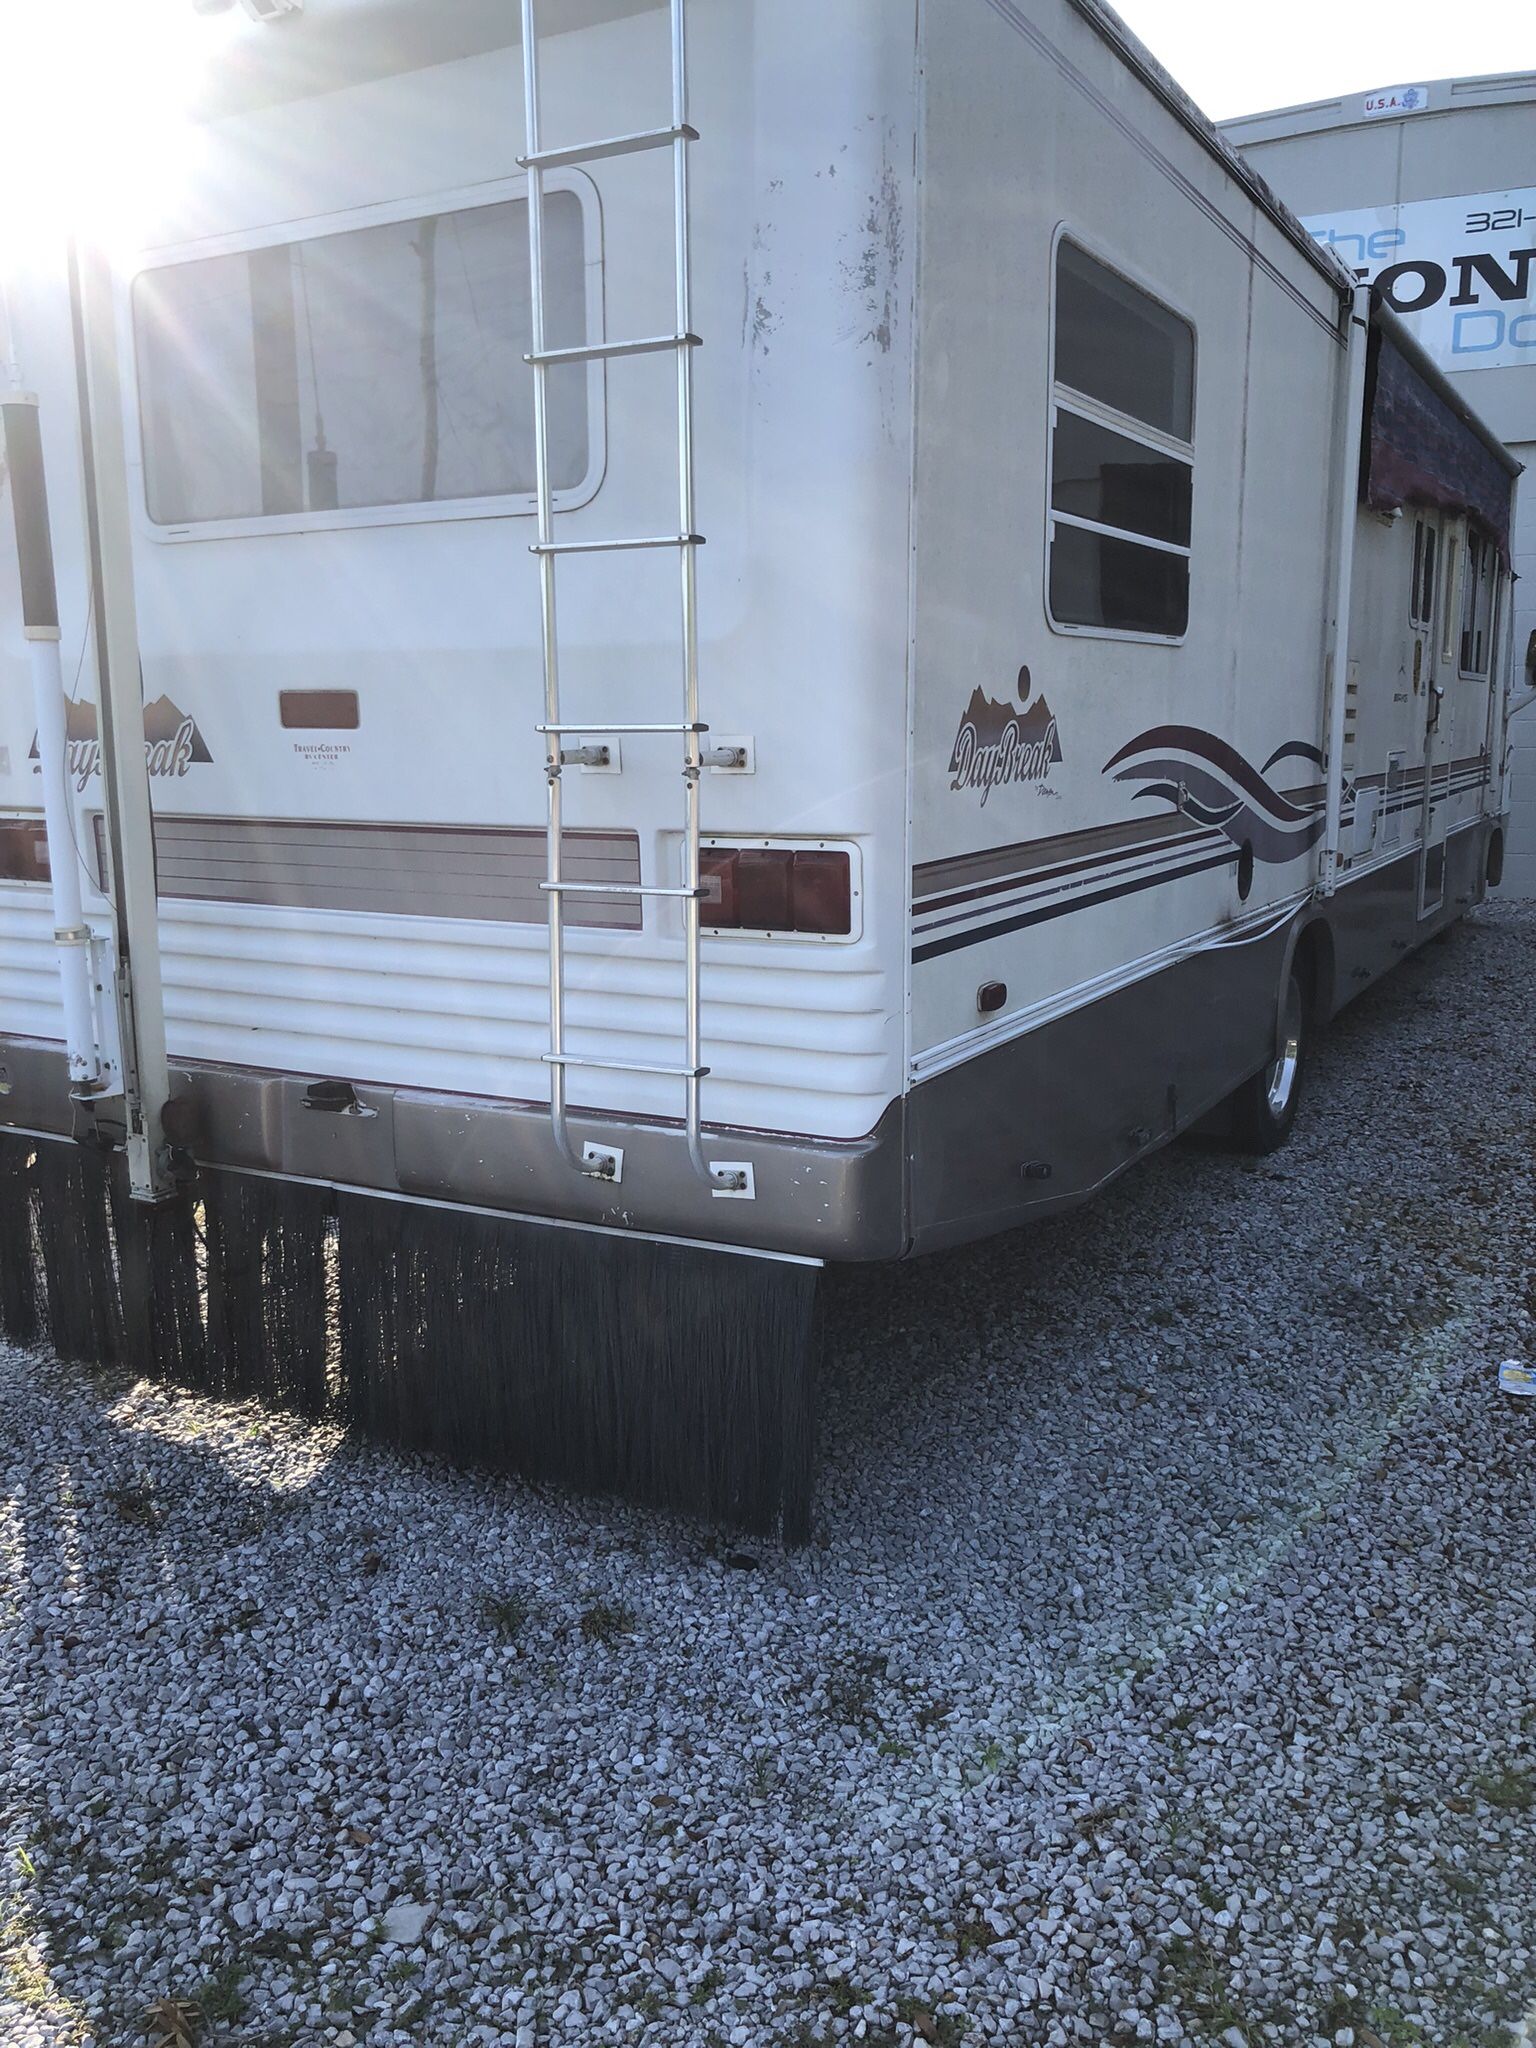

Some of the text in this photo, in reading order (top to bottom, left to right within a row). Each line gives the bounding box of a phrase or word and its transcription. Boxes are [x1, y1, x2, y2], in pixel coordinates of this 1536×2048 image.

[1365, 96, 1401, 111] U.S.A.
[1311, 227, 1406, 260] he
[950, 722, 1055, 808] DayBreak
